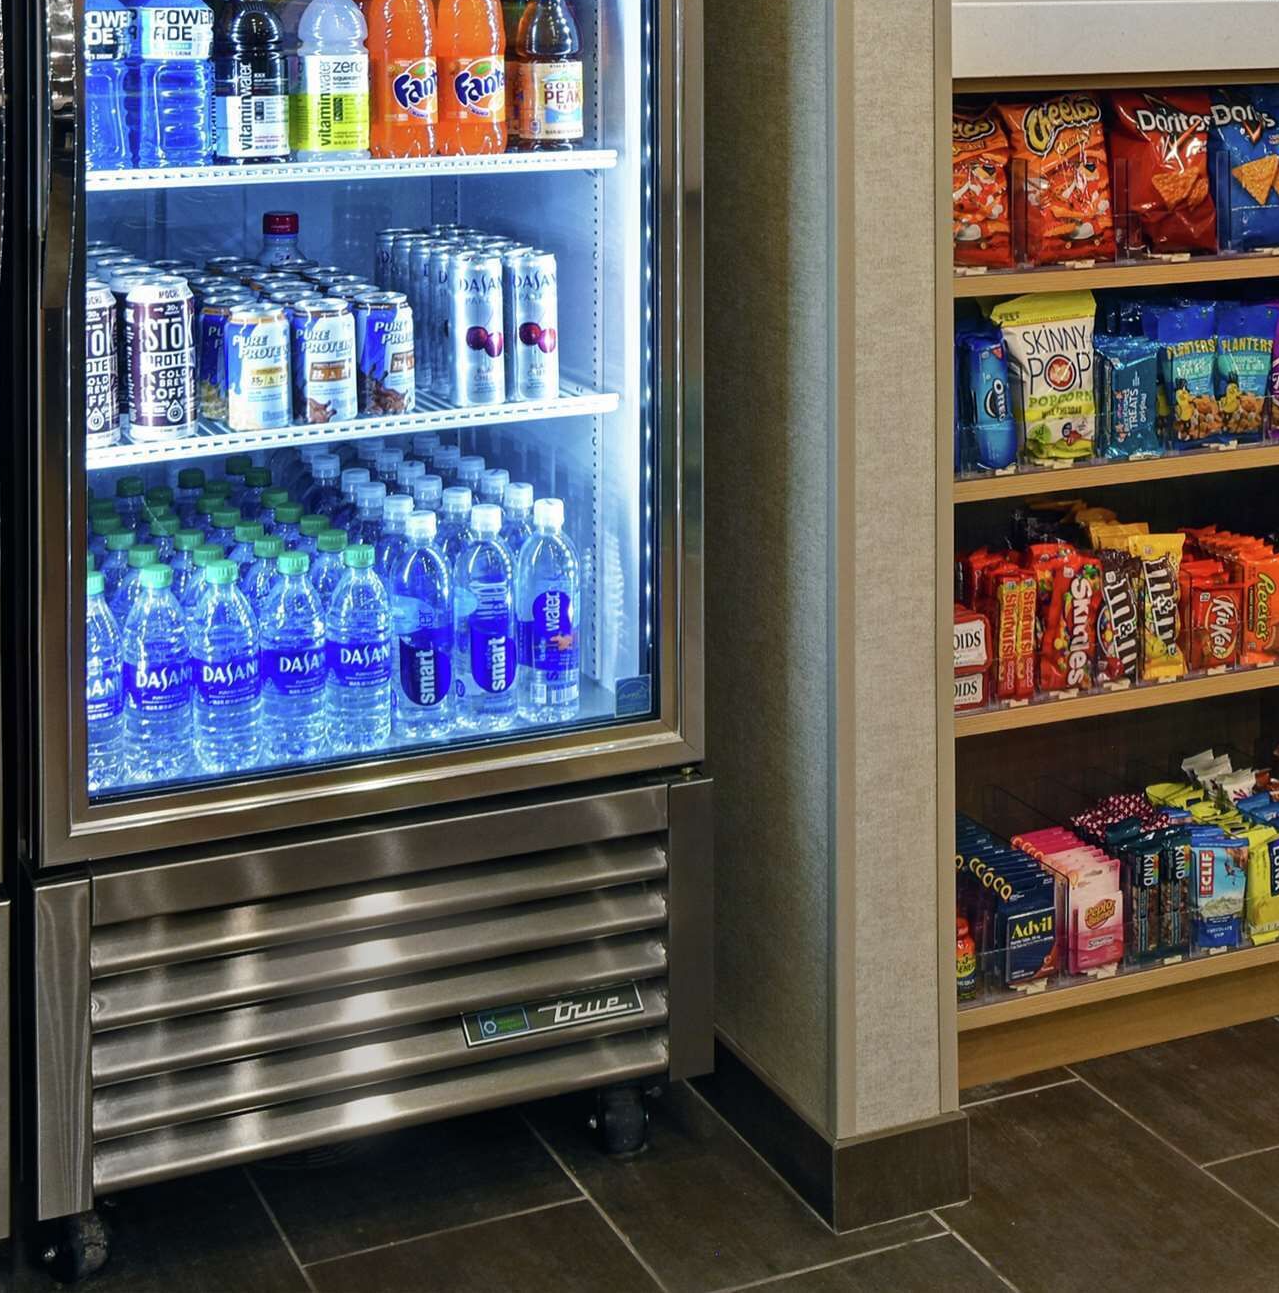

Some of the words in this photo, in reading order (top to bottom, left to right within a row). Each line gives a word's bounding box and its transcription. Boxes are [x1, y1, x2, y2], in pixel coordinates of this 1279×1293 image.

[332, 62, 362, 73] zero
[239, 63, 253, 150] vitaminwater
[320, 61, 331, 147] vitaminwater
[544, 90, 582, 104] PEAK
[1024, 96, 1101, 154] Cheetos
[1137, 110, 1210, 132] Doritos
[233, 335, 269, 347] PURE
[296, 329, 331, 341] PURE
[1023, 325, 1086, 356] SKINNY
[1167, 339, 1217, 359] PLANTERS
[1221, 338, 1273, 352] PLANTERS
[159, 370, 187, 378] COLD
[1028, 352, 1091, 395] POP
[993, 378, 1005, 422] OREO
[1029, 391, 1094, 406] POPCORN
[1130, 388, 1139, 430] TREATS
[545, 587, 560, 631] water
[1023, 590, 1035, 656] Starburst
[1256, 572, 1276, 640] Reese's
[1005, 594, 1015, 660] Starburst
[1067, 578, 1092, 686] Skittles
[136, 665, 192, 691] DASANI
[202, 658, 259, 686] DASANI
[416, 649, 434, 704] smart
[488, 636, 506, 690] smart
[1144, 854, 1154, 886] KIND
[1176, 845, 1186, 879] KIND
[1200, 852, 1213, 895] CLIF
[1012, 916, 1052, 939] Advil
